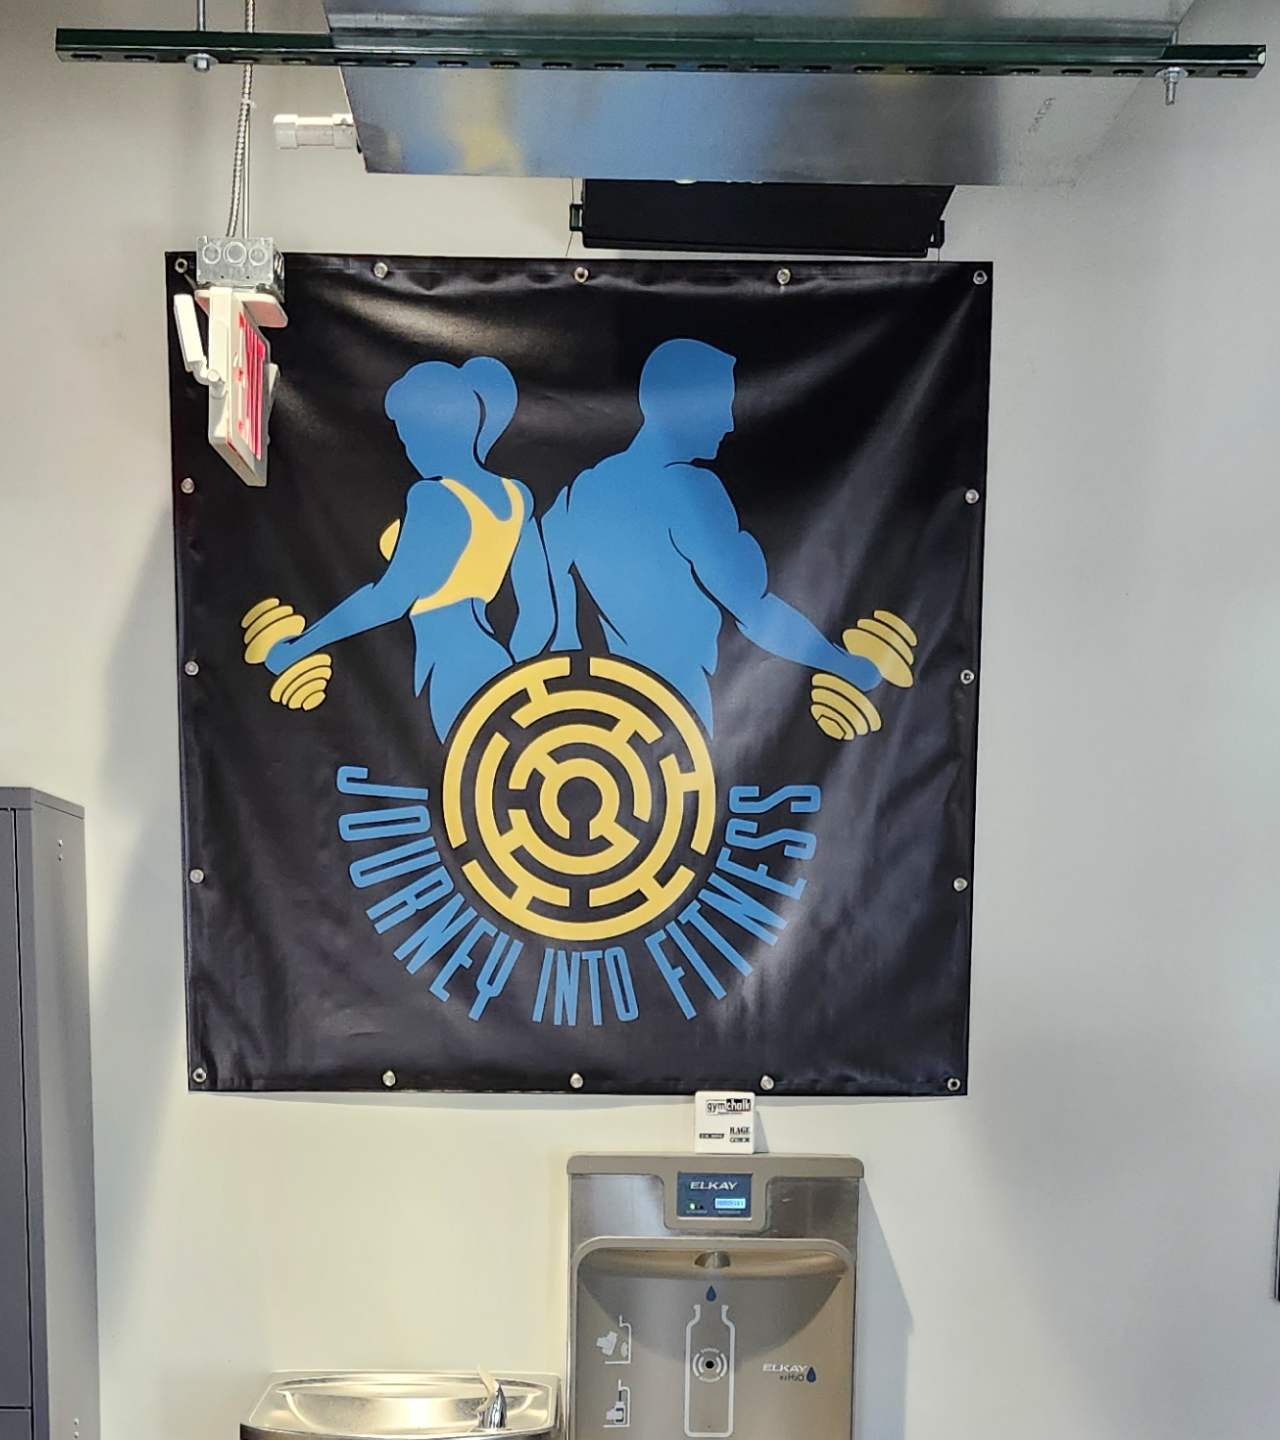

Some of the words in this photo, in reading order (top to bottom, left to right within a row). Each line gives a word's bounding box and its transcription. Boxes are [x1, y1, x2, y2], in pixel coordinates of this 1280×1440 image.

[336, 766, 523, 1021] JOURNEY
[532, 946, 639, 1026] INTO
[644, 784, 821, 1021] FITNESS
[690, 1180, 738, 1190] ELKAY
[762, 1363, 808, 1373] ELKAY
